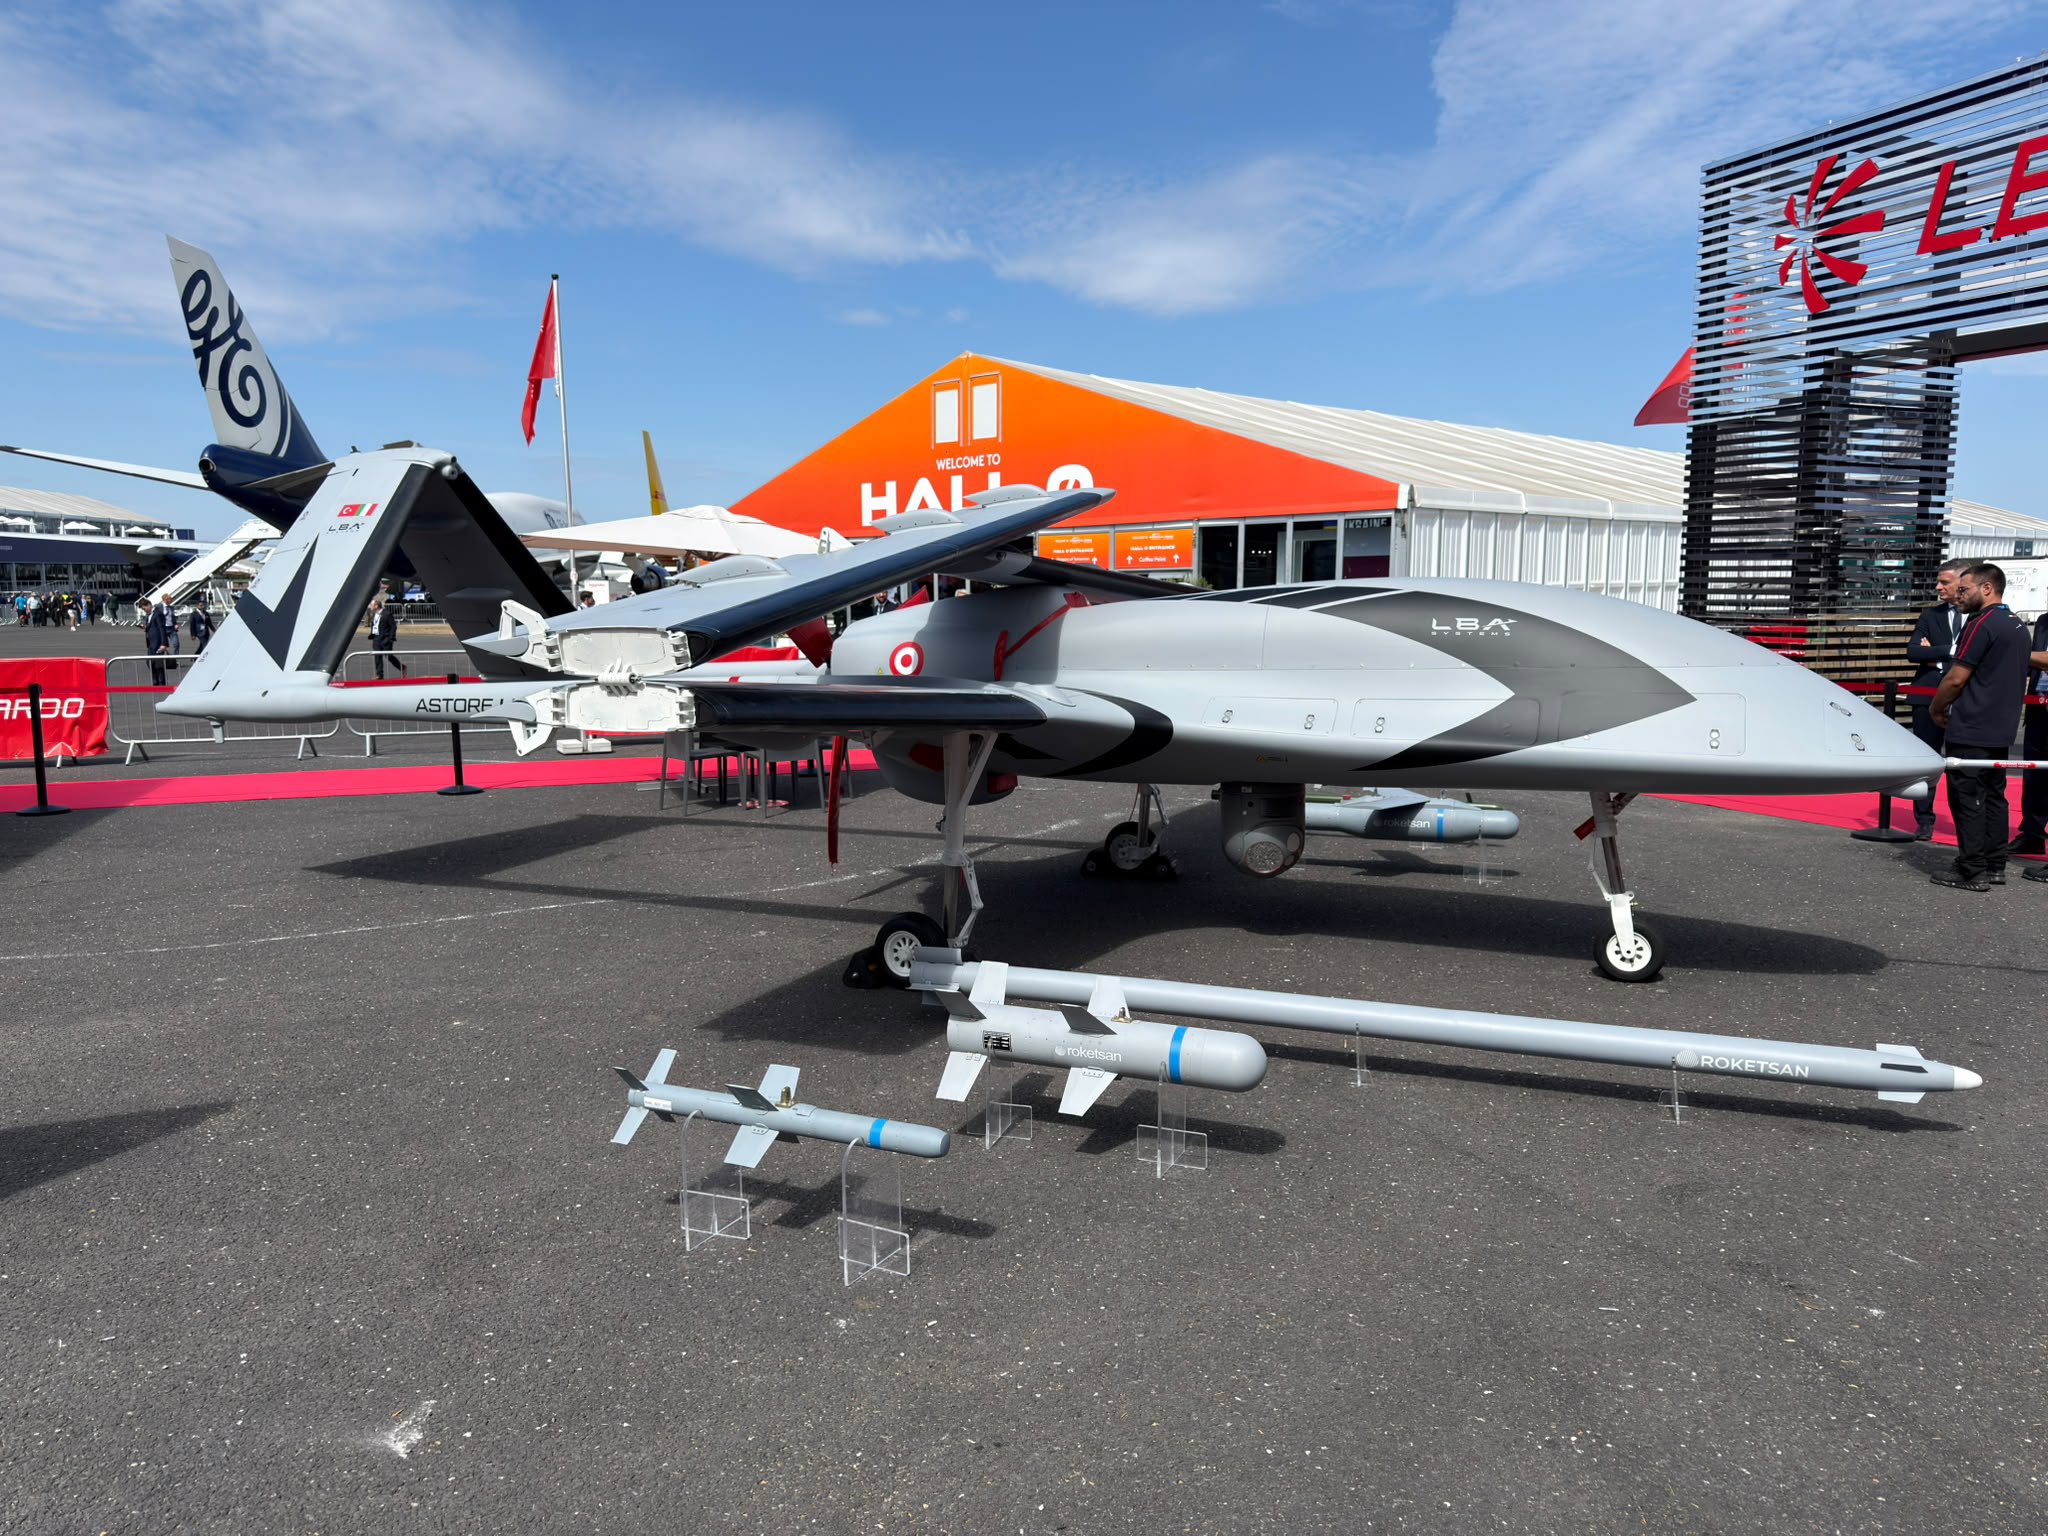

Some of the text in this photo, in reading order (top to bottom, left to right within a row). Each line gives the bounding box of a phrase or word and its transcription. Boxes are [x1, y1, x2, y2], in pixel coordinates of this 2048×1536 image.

[936, 453, 1001, 471] WELCOME TO
[1431, 617, 1518, 631] LBA
[1067, 1046, 1122, 1062] roketsan
[1700, 1055, 1810, 1078] ROKETSAN
